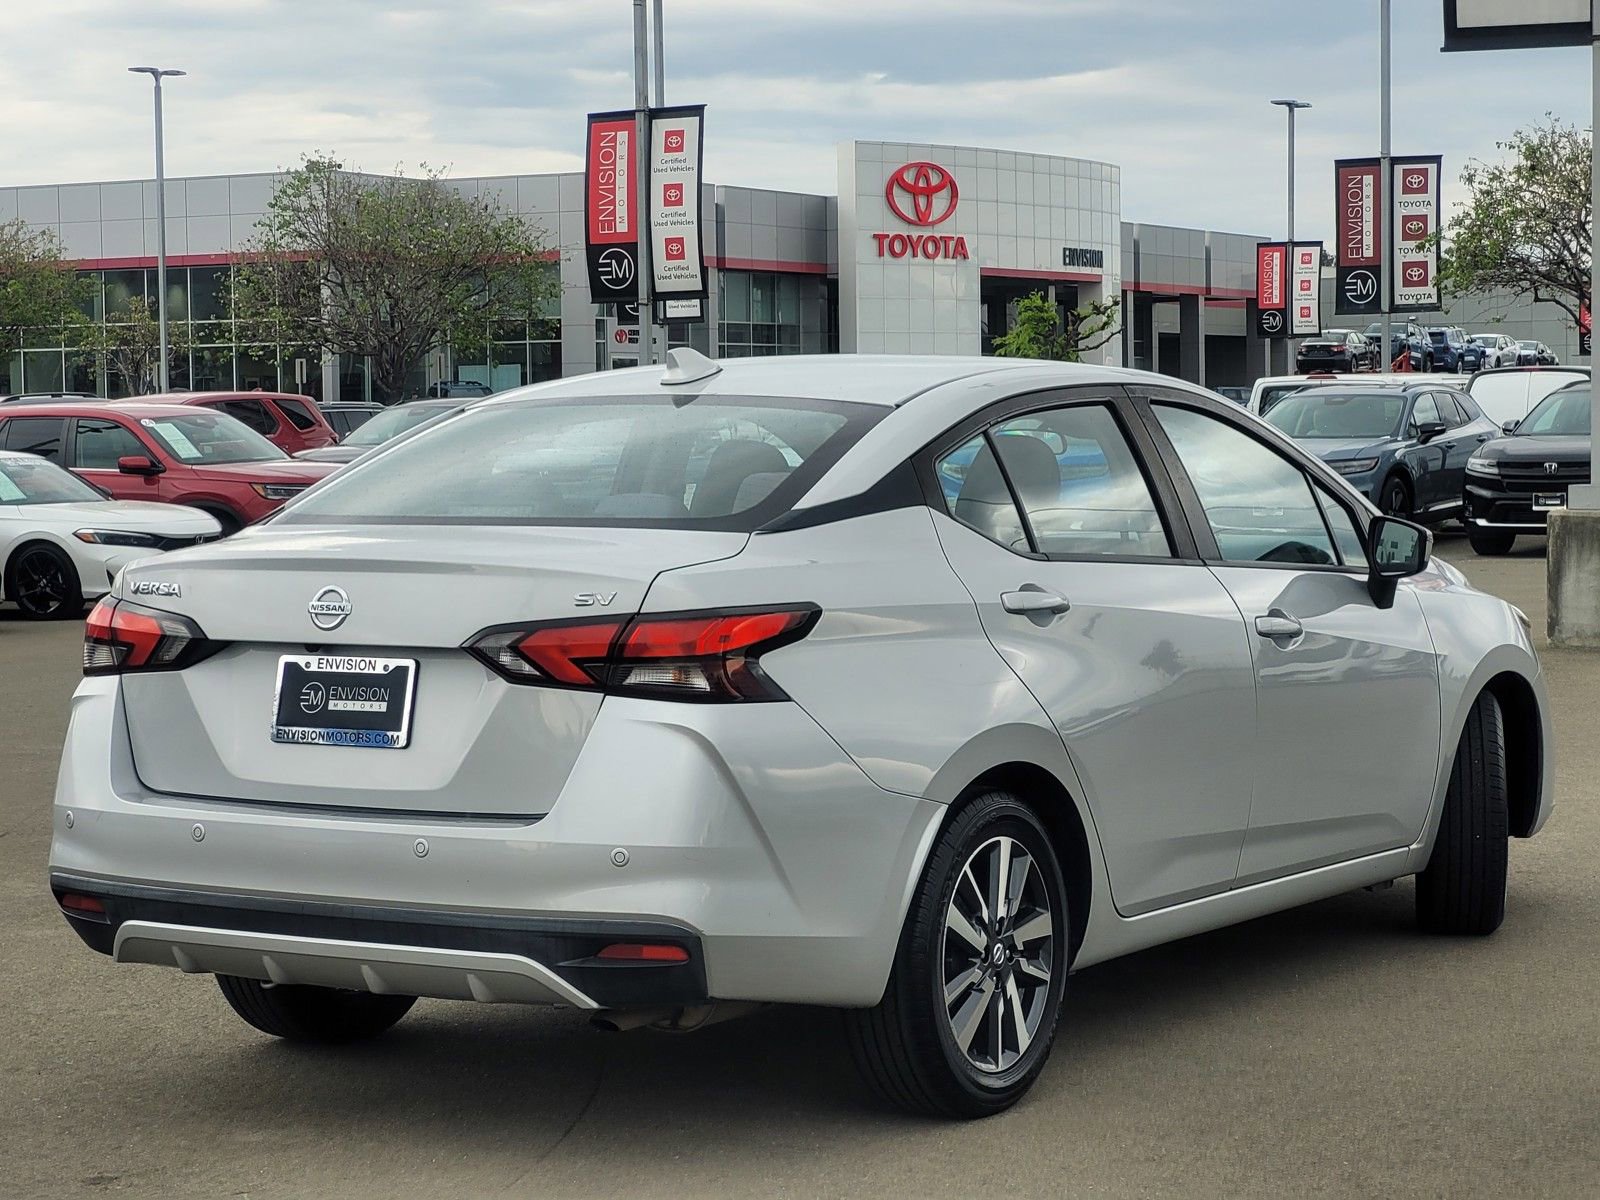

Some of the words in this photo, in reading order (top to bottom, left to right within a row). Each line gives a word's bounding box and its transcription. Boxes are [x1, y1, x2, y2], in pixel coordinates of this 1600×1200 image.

[599, 131, 615, 234] ENVISION
[618, 140, 626, 224] MOTORS
[1398, 200, 1432, 208] TOYOTA
[1347, 175, 1362, 259] ENVISION
[1364, 182, 1372, 251] MOTORS
[873, 233, 969, 260] TOYOTA
[1398, 247, 1432, 255] TOYOTA
[1062, 247, 1103, 268] ENVISION
[1264, 252, 1273, 304] ENVISION
[1399, 292, 1433, 301] TOYOTA
[130, 582, 182, 598] VERSA
[574, 591, 617, 607] SV
[310, 603, 345, 613] NISSAN
[317, 658, 377, 672] ENVISION
[329, 686, 389, 701] ENVISION
[333, 702, 382, 710] MOTORS
[276, 728, 400, 746] ENVISIONMOTORS.COM
